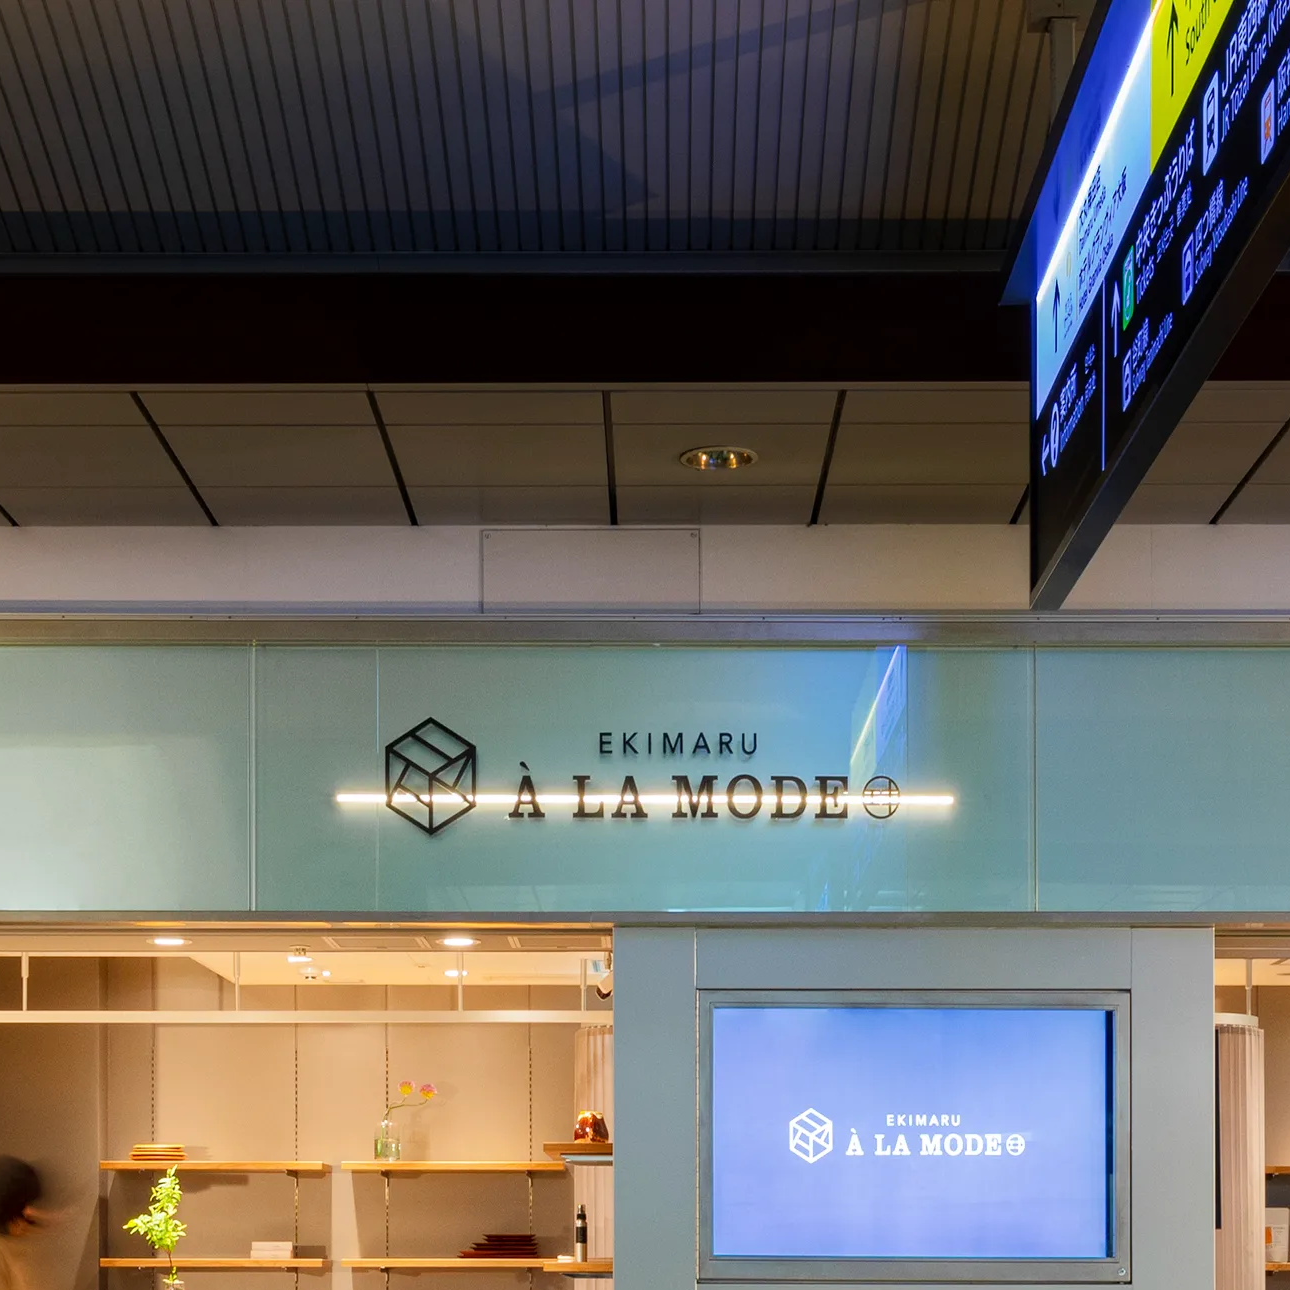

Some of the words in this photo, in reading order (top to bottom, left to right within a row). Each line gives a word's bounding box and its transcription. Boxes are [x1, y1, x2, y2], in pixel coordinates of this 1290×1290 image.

[1221, 103, 1229, 143] JR
[1250, 33, 1266, 83] Line
[1136, 118, 1195, 268] 中央きっぷうりば
[1136, 255, 1155, 304] Tickets
[599, 732, 758, 756] EKIMARU
[509, 761, 546, 819] À
[572, 775, 648, 819] LA
[671, 774, 849, 820] MODE
[845, 1128, 864, 1156] À
[874, 1133, 911, 1156] LA
[919, 1133, 1002, 1156] MODE
[886, 1114, 960, 1127] EKIMARU
